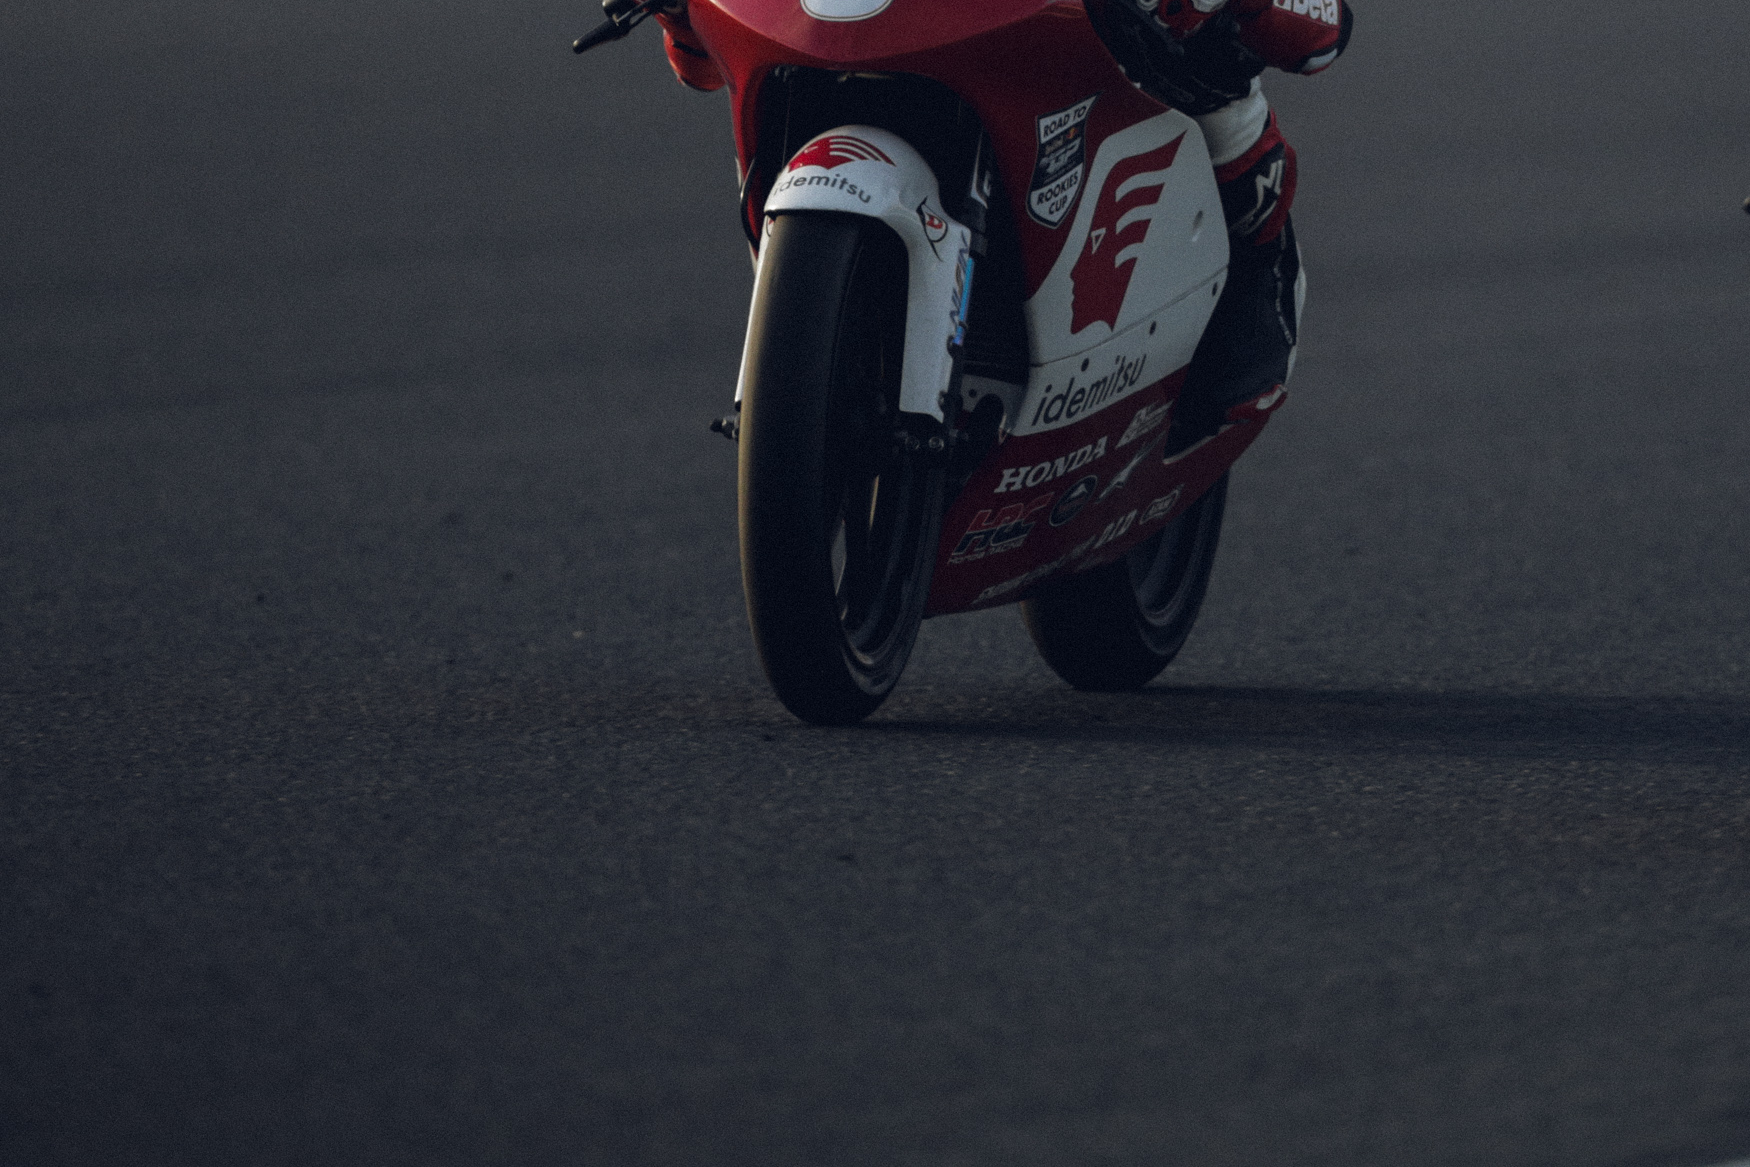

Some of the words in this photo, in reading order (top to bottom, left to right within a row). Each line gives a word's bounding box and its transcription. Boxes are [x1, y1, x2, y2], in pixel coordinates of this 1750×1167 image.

[1043, 113, 1071, 137] ROAD
[1037, 170, 1079, 206] ROOKIES
[1048, 194, 1069, 216] CUP
[1031, 353, 1148, 427] idemitsu
[993, 435, 1110, 495] HONDA
